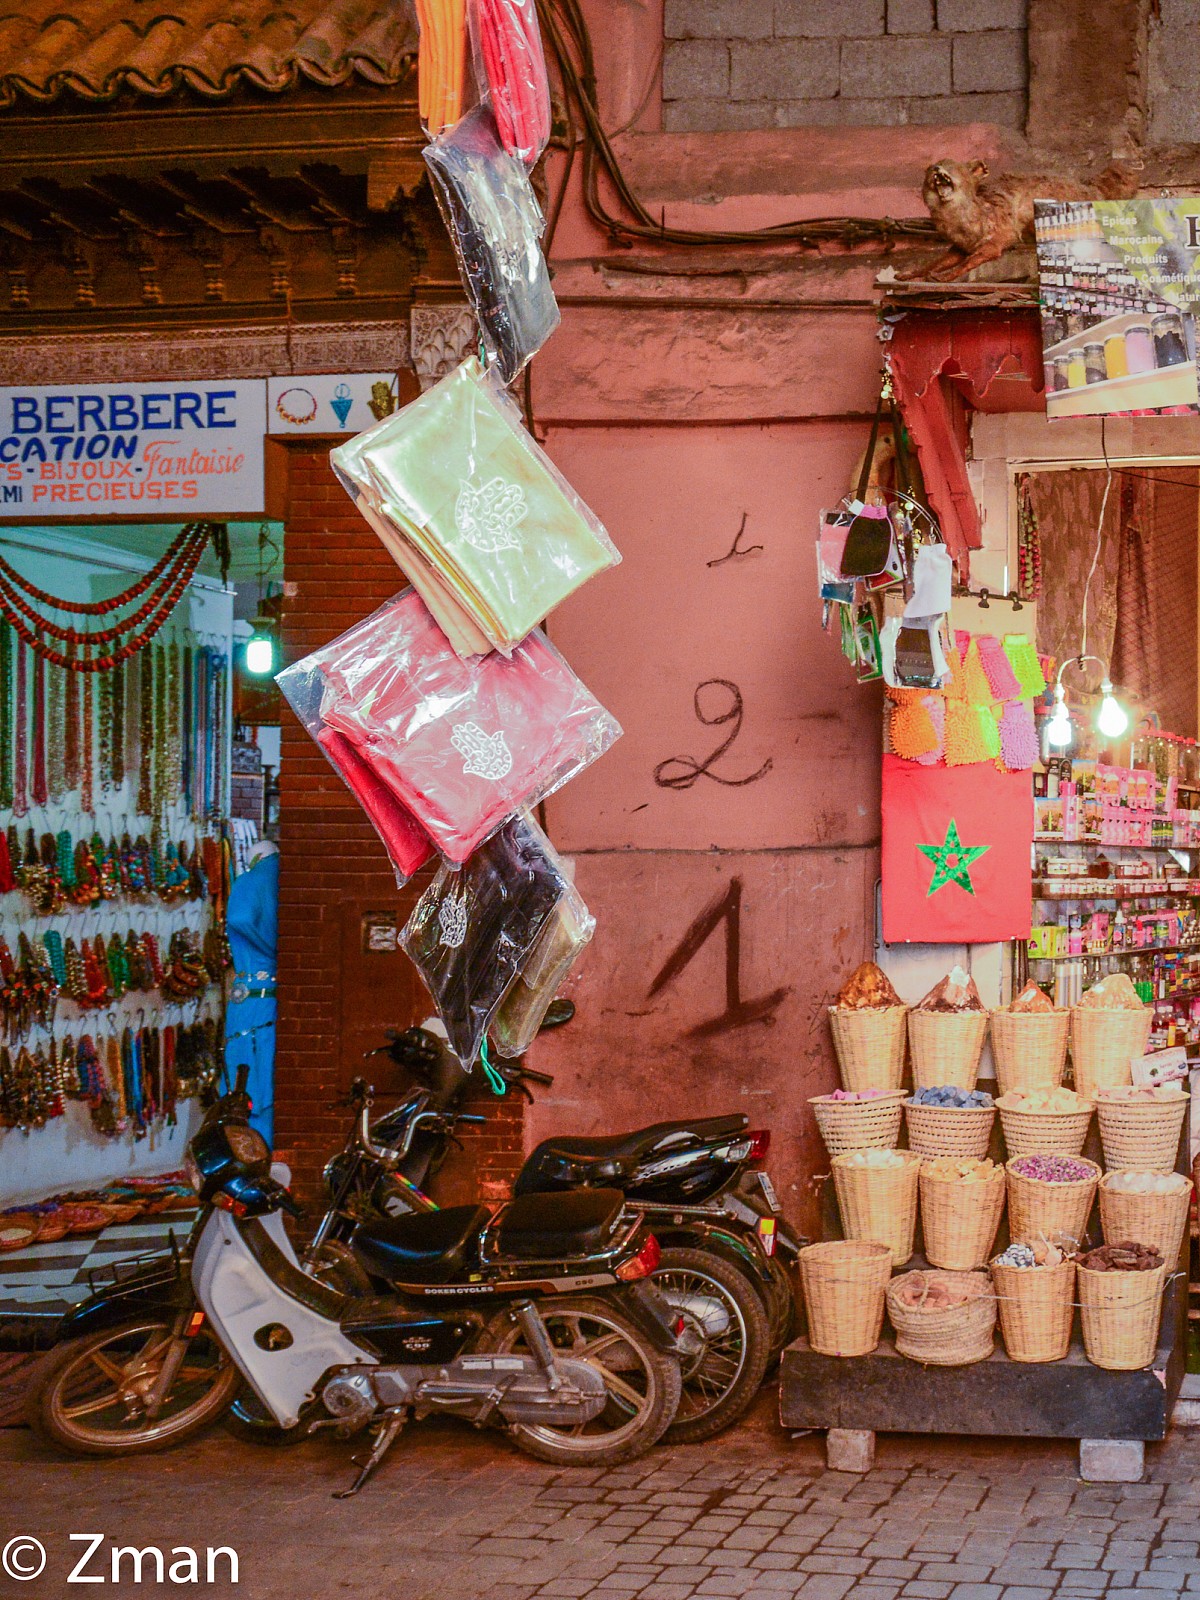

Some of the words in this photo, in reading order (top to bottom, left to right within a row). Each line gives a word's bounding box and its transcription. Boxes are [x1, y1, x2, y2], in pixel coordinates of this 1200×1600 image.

[1102, 215, 1138, 228] Epices
[1110, 235, 1164, 246] Marocains
[1124, 254, 1169, 265] Produits
[11, 390, 237, 435] BERBERE
[0, 434, 138, 463] CATION
[39, 460, 135, 481] BIJOUX
[143, 440, 246, 482] Fantaisie
[32, 481, 199, 503] PRECIEUSES
[456, 1285, 494, 1294] CYCLES
